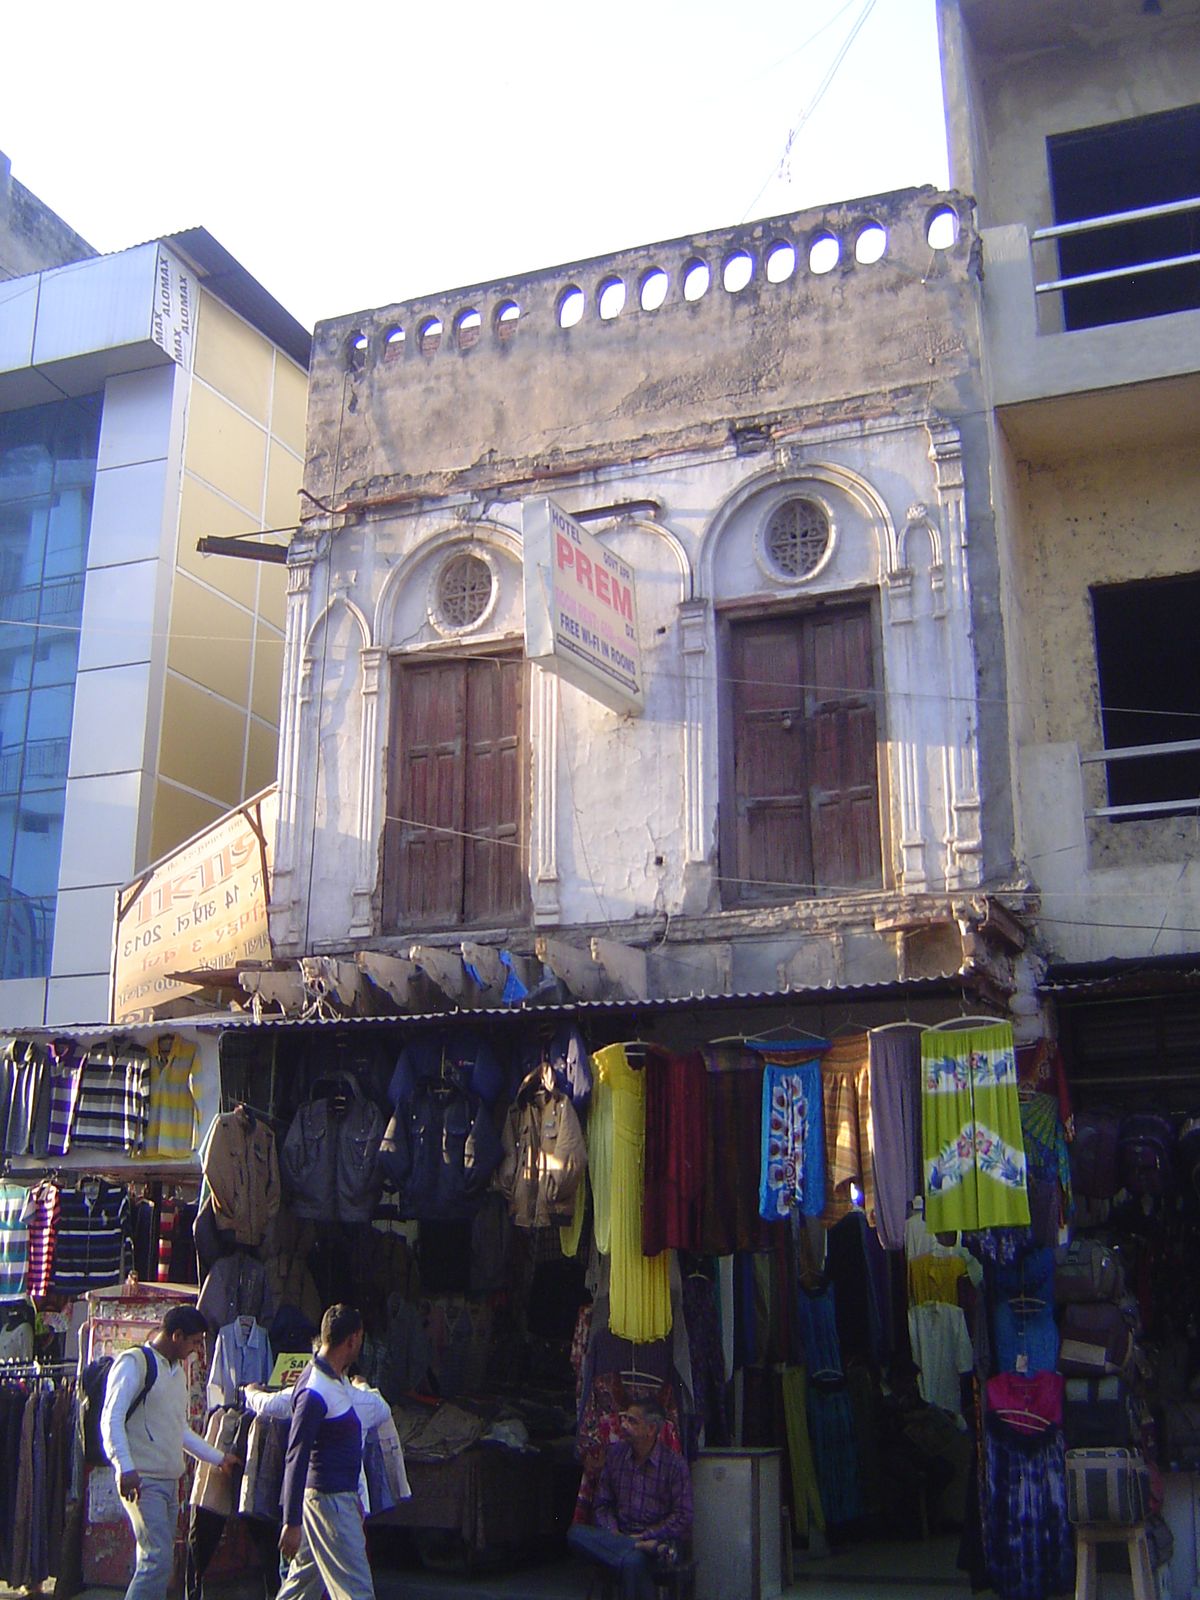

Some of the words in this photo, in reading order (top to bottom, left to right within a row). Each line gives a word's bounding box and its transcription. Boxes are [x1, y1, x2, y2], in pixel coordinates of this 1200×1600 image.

[160, 257, 170, 318] ALOMAX
[179, 275, 190, 335] ALOMAX
[552, 509, 581, 544] HOTEL
[556, 532, 633, 621] PREM
[560, 612, 579, 638] FREE
[582, 626, 600, 652] WI-FI
[601, 640, 609, 658] IN
[611, 646, 636, 676] ROOMS
